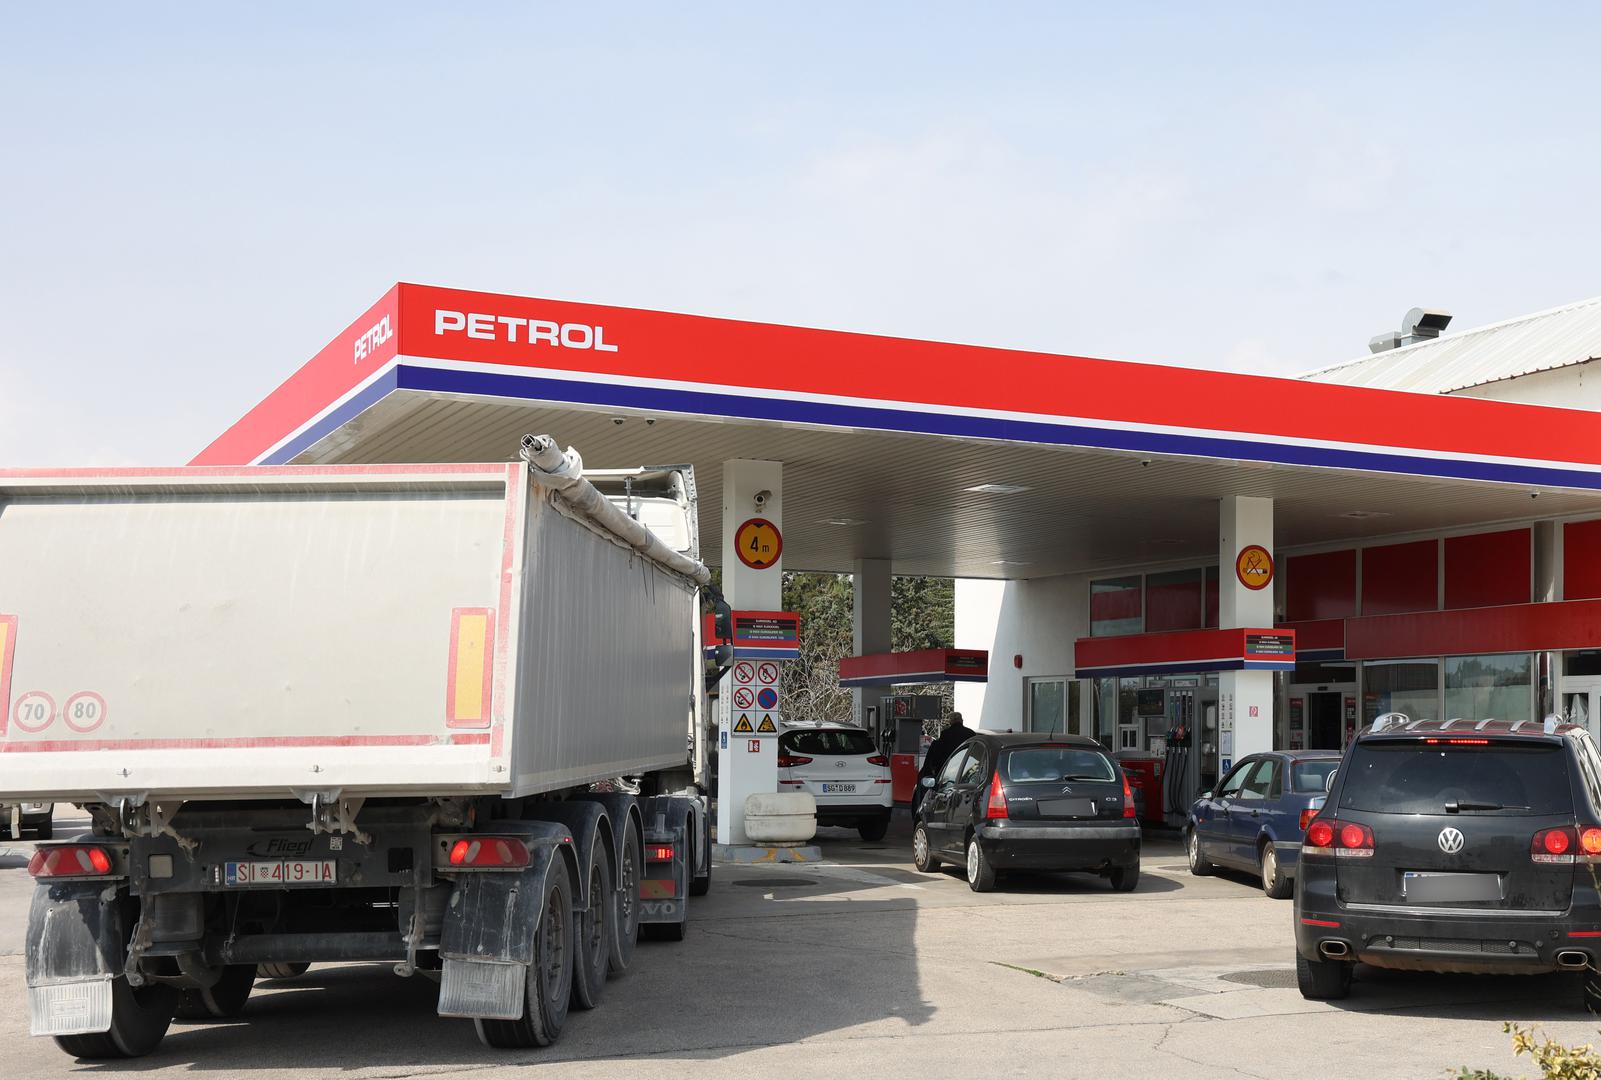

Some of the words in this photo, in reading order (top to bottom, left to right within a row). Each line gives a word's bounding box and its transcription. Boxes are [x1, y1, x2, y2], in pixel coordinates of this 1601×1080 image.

[434, 309, 618, 352] PETROL
[354, 314, 393, 365] PETROL
[750, 536, 759, 552] 4
[24, 703, 45, 720] 70
[74, 702, 96, 718] 80
[267, 839, 315, 855] Fliegl
